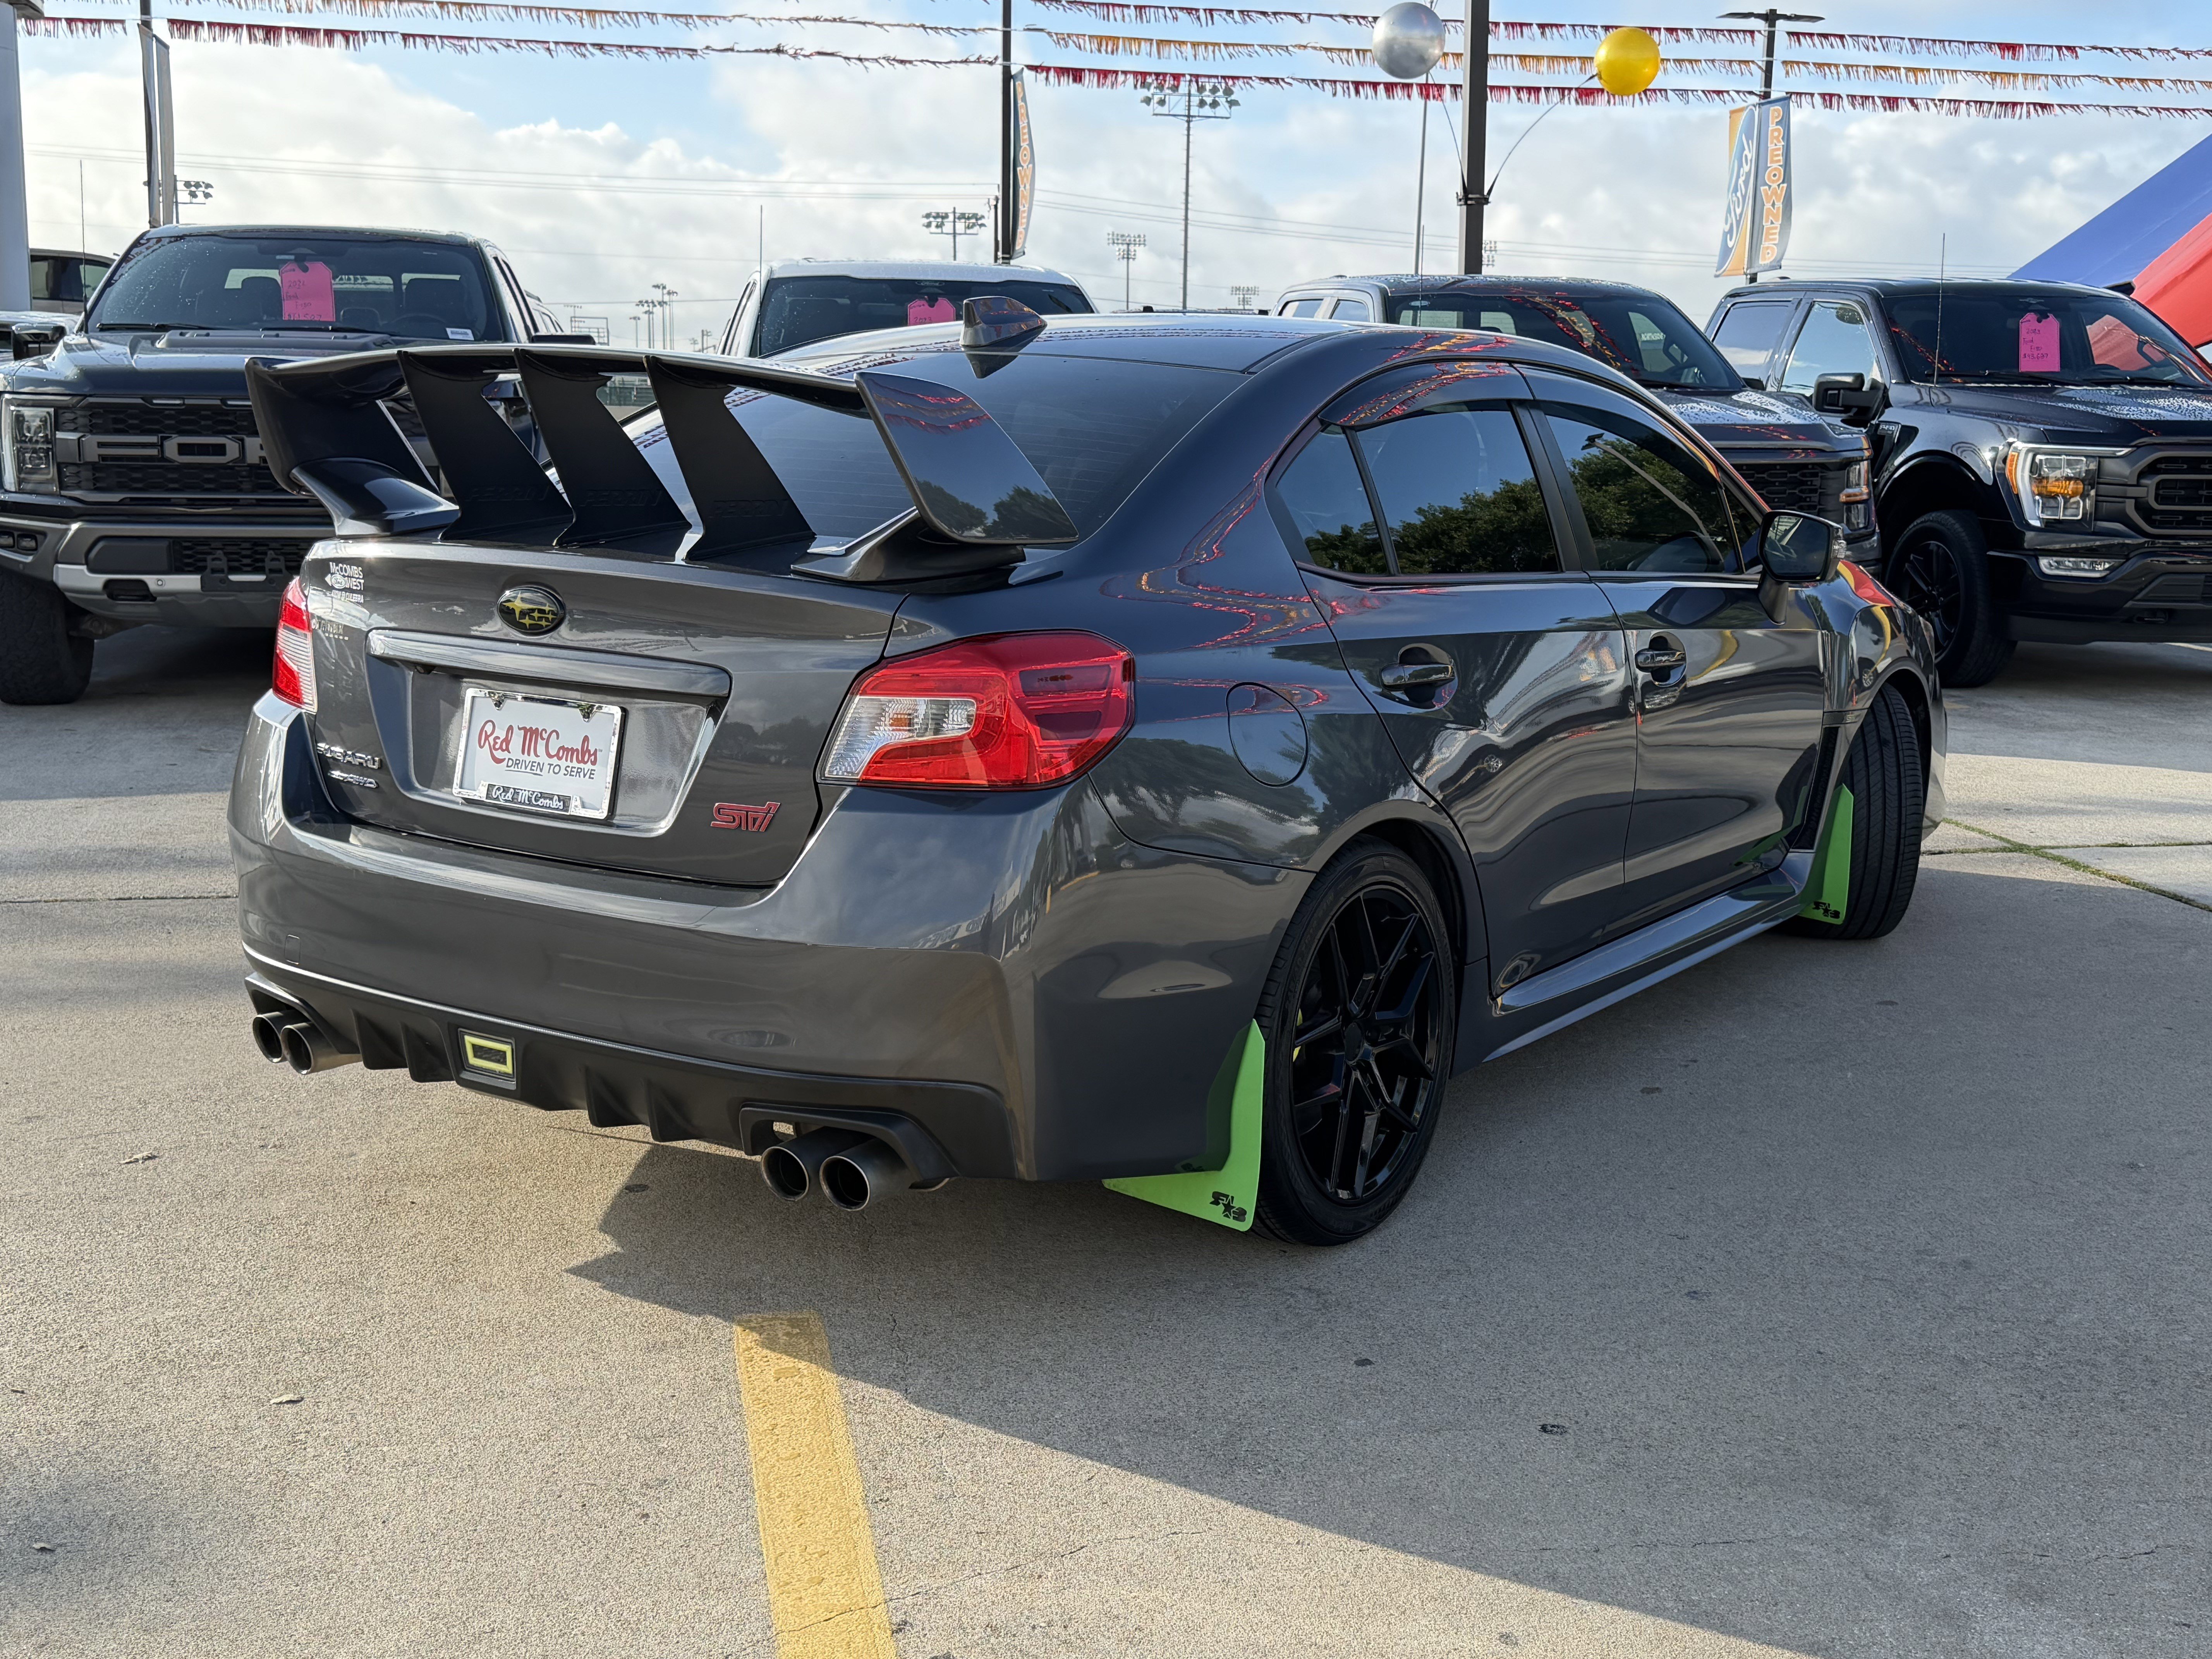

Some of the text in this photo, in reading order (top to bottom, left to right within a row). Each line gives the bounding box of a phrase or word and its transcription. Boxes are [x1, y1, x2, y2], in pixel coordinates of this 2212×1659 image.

[1015, 81, 1032, 250] PREOWNED
[1724, 133, 1752, 248] Ford
[1759, 106, 1787, 264] PREOWNED
[579, 489, 663, 507] PERRIN
[708, 499, 789, 518] PERRIN
[330, 562, 363, 579] McCOMBS
[345, 577, 364, 591] WEST
[477, 719, 598, 766] Red McCombs
[506, 757, 596, 780] DRIVEN TO SERVE
[491, 785, 564, 810] Red McCombs
